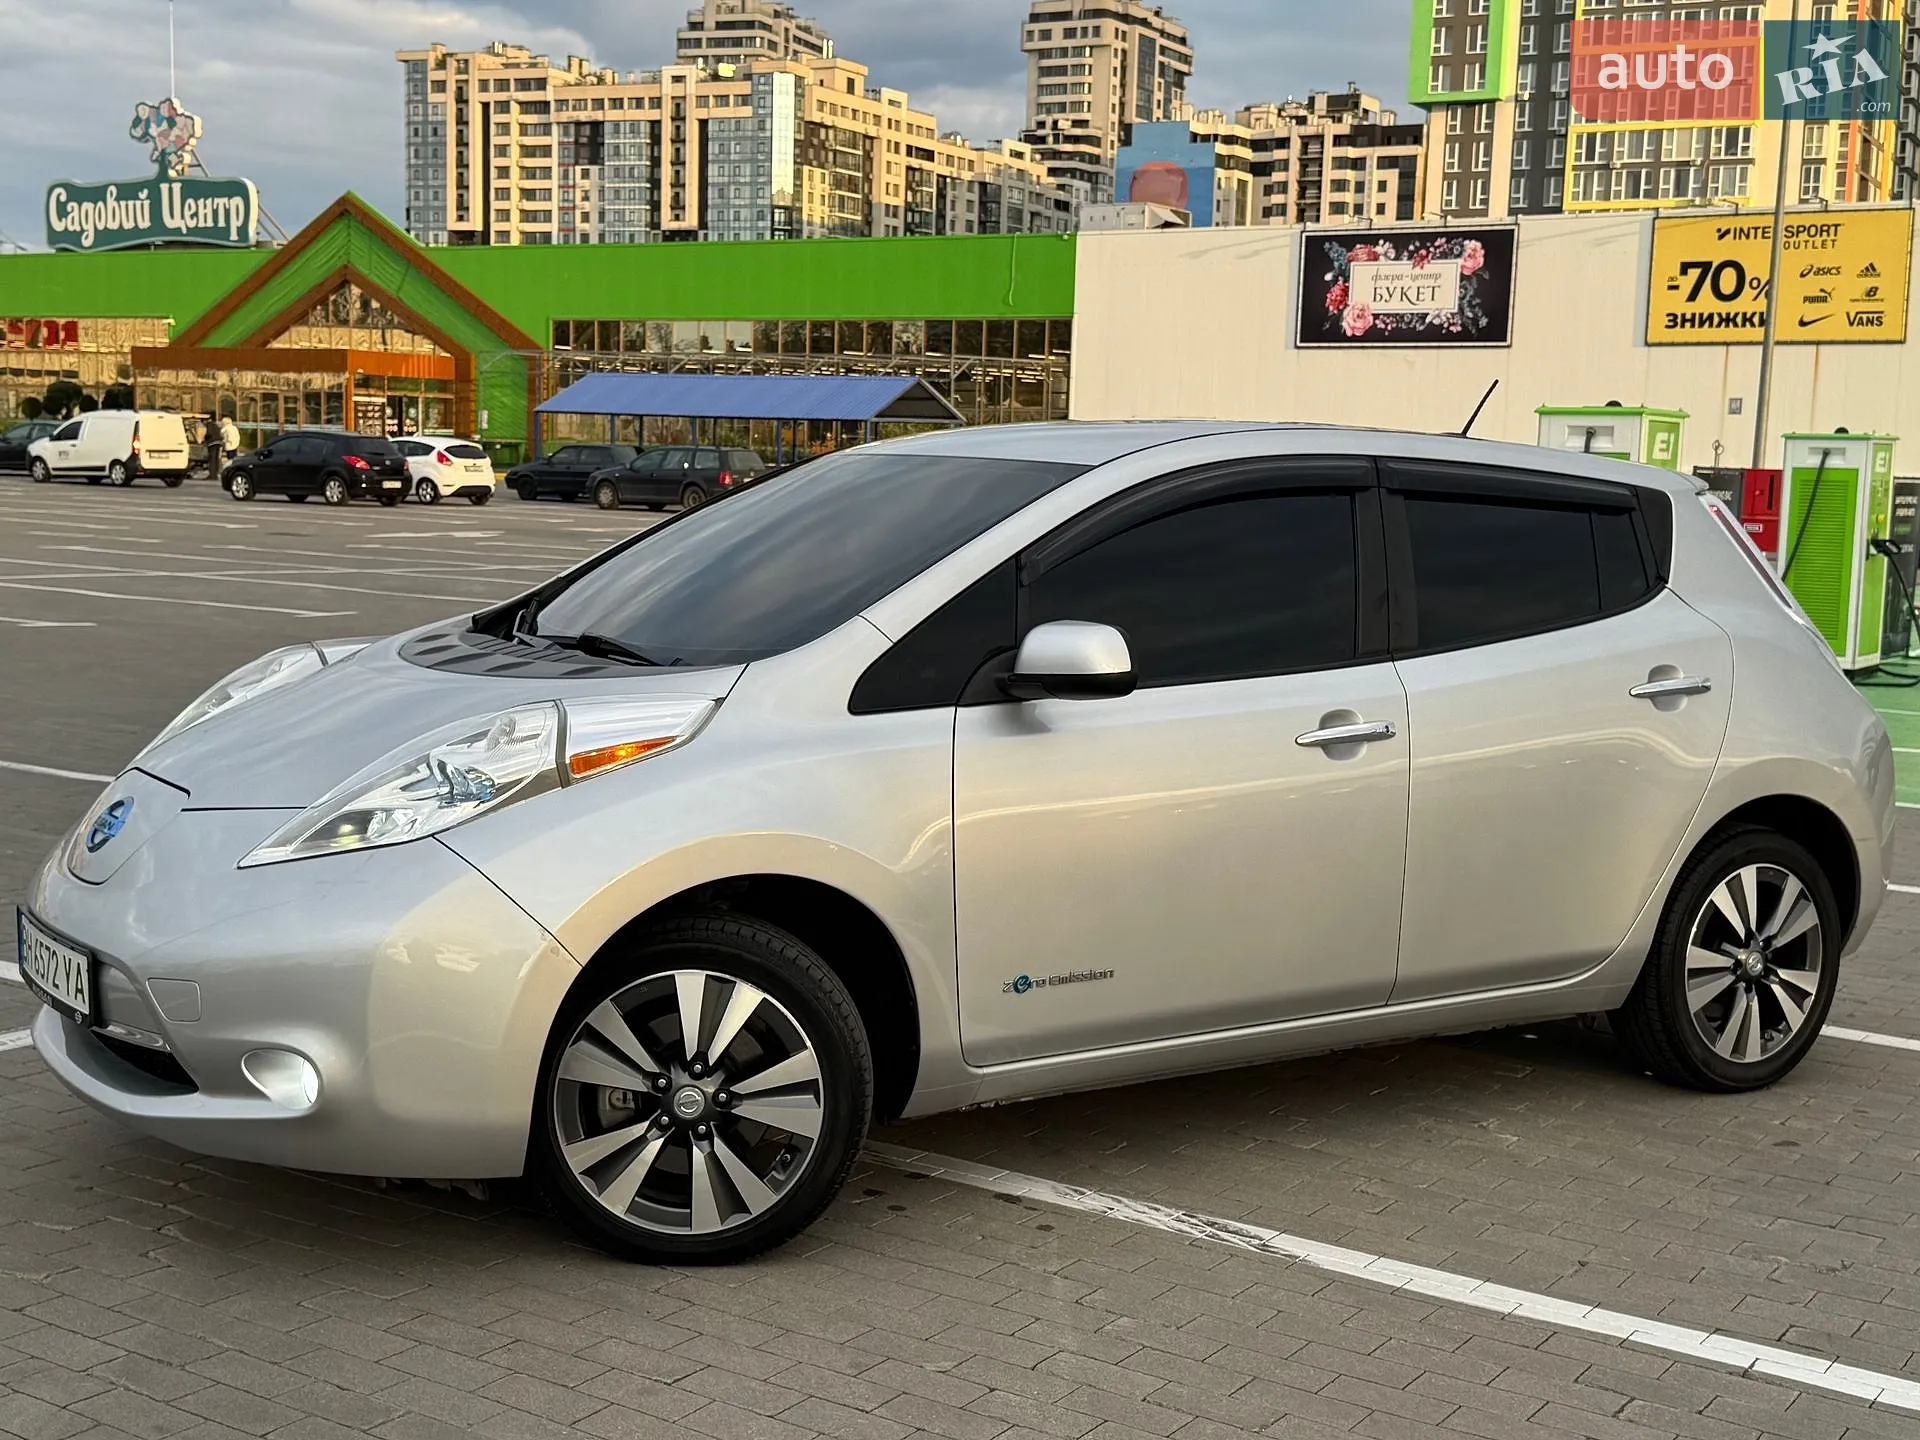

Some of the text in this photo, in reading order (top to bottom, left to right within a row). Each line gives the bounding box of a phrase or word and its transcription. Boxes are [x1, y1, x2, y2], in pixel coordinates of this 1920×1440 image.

[49, 182, 245, 248] Садовий Центр
[1733, 223, 1840, 241] INTESPORT
[1783, 239, 1838, 250] OUTLET
[1373, 285, 1441, 306] БУКЕТ
[1846, 311, 1885, 327] VANS
[35, 938, 60, 990] 6572
[63, 954, 86, 1005] YA
